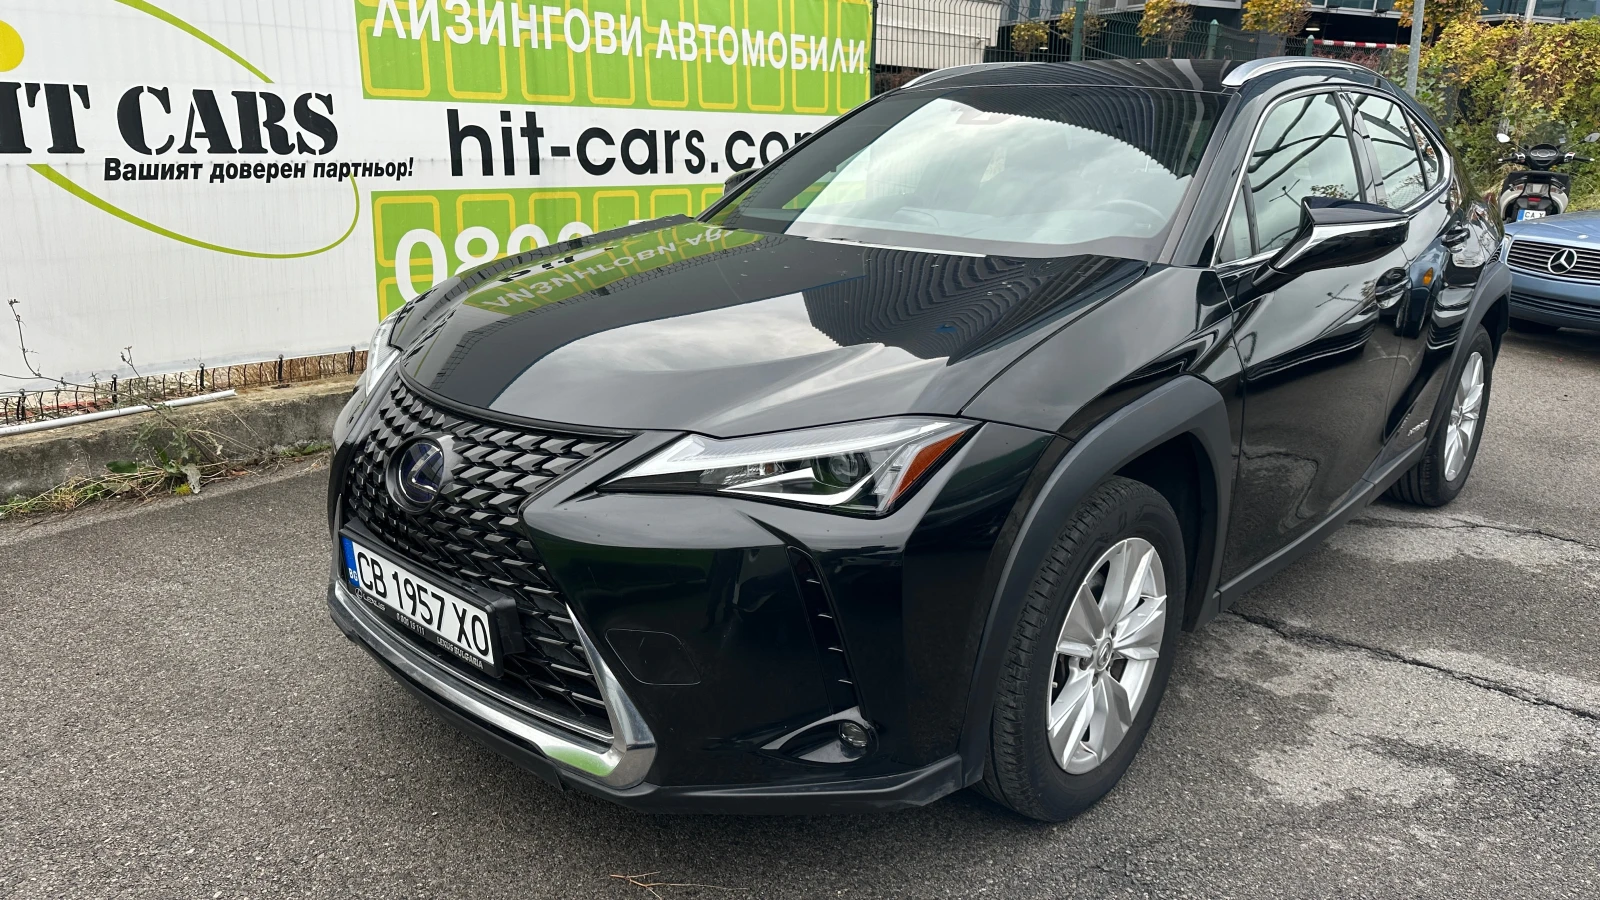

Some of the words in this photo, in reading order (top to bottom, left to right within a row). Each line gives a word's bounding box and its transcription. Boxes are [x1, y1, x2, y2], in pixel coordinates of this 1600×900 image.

[372, 0, 642, 58] ЛИЗИНГОВИ
[655, 19, 865, 74] АВТОМОБИЛИ
[117, 85, 339, 156] CARS
[446, 108, 814, 177] hit-cars.co
[104, 158, 203, 181] Вашият
[209, 163, 306, 183] доверен
[313, 157, 414, 182] партньор!
[348, 567, 358, 582] BG
[357, 551, 388, 599] CB
[391, 570, 446, 632] 1957
[451, 601, 490, 657] XO
[436, 636, 454, 651] LEXUS
[453, 646, 484, 670] BULGARIA
